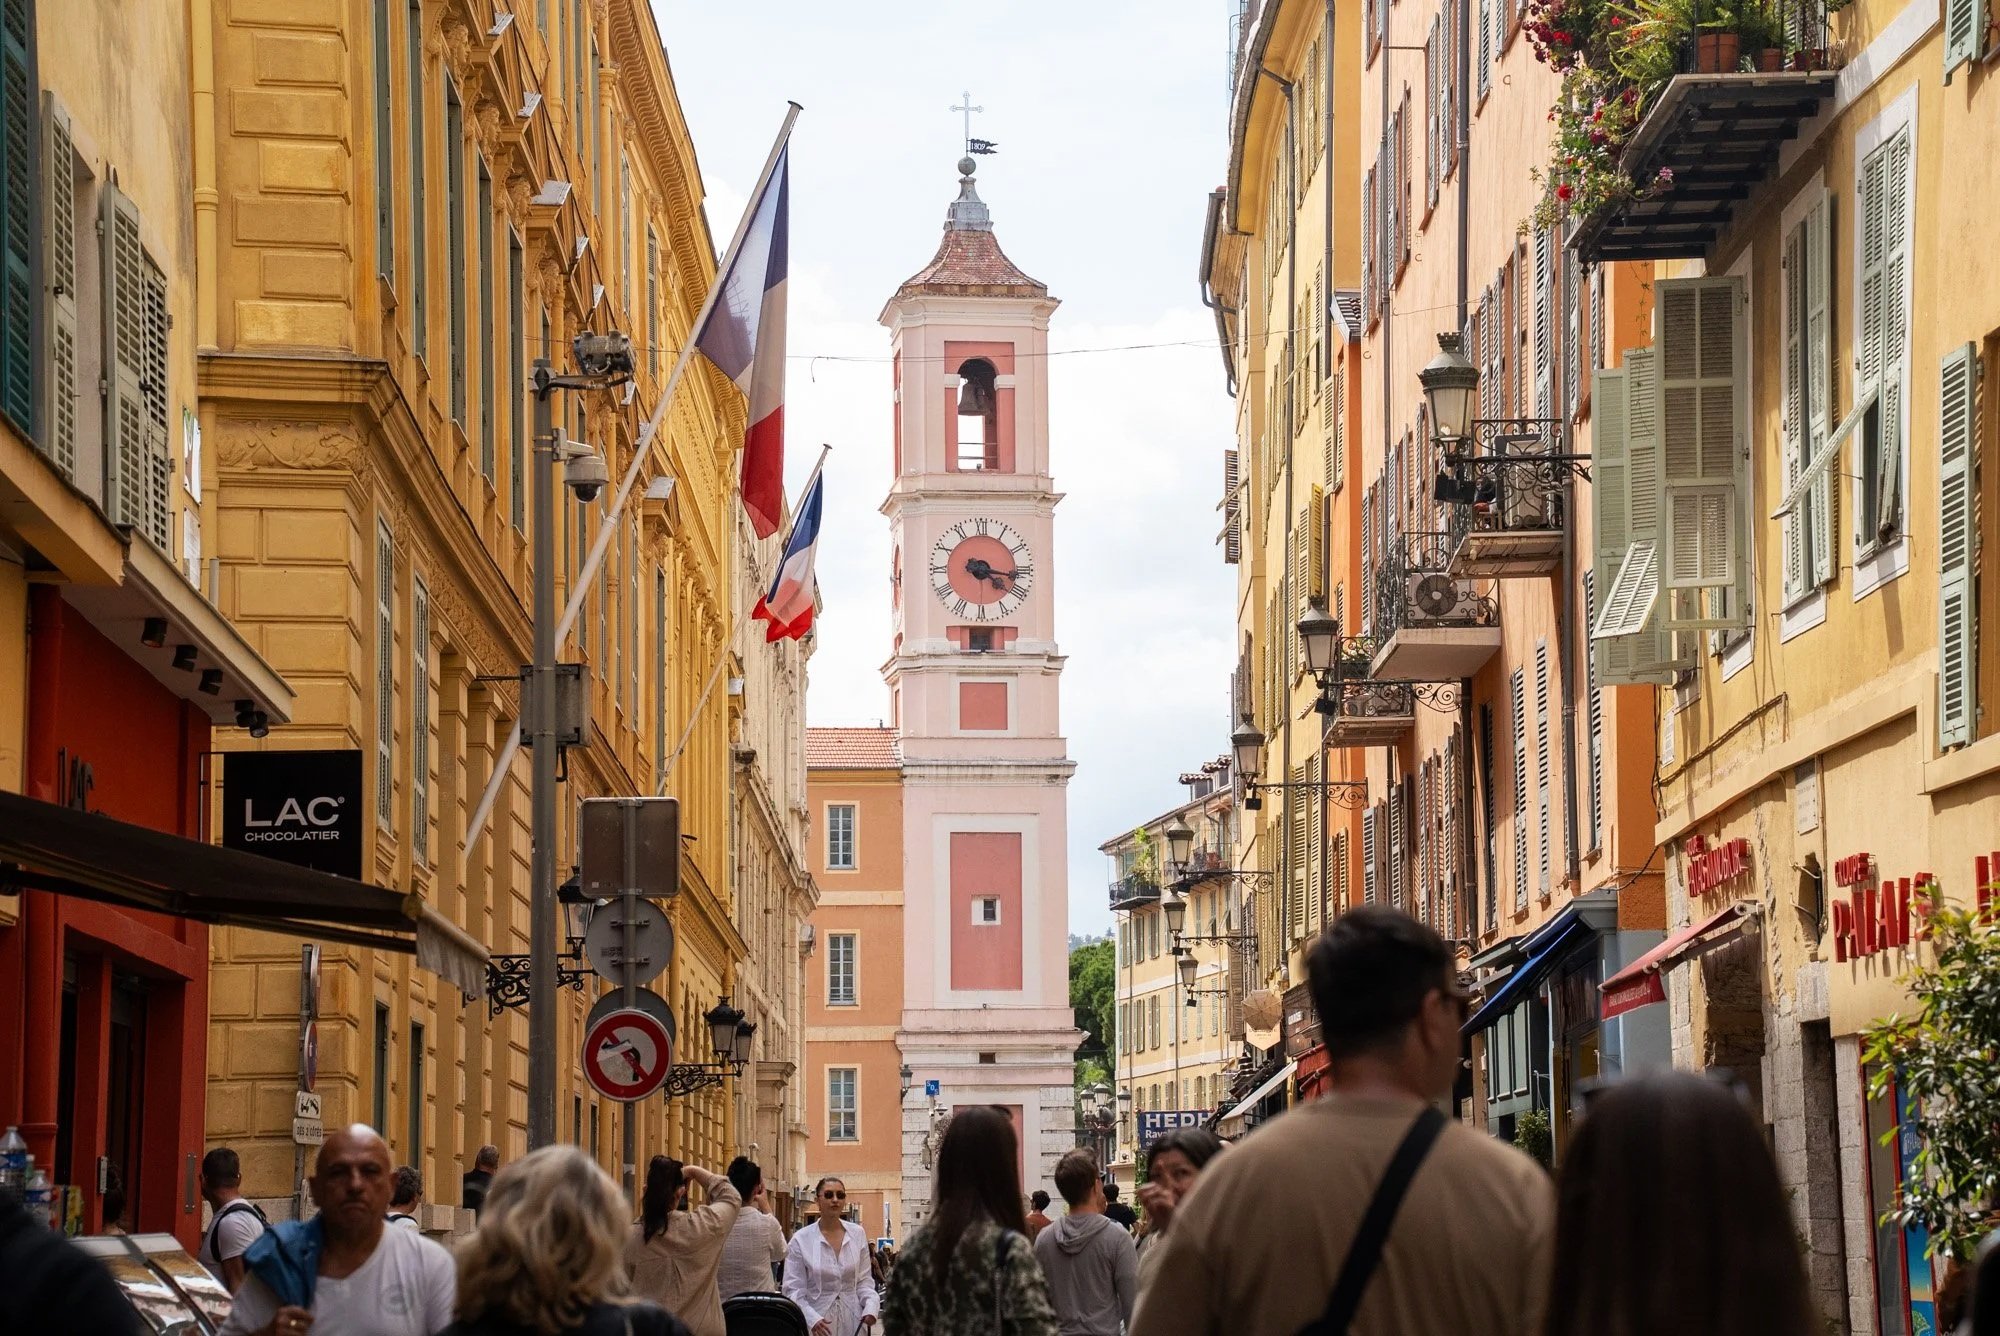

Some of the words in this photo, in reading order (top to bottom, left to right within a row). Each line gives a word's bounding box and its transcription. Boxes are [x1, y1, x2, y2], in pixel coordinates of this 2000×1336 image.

[971, 142, 986, 150] 1809
[954, 526, 967, 540] XI
[976, 521, 987, 535] XII
[998, 527, 1007, 540] I
[938, 543, 952, 555] X
[1010, 543, 1024, 555] II
[933, 565, 947, 574] IX
[936, 582, 953, 600] VIII
[954, 598, 967, 615] VII
[978, 604, 986, 620] VI
[999, 600, 1009, 614] V
[245, 831, 340, 842] CHOCOLATIER
[1832, 872, 1933, 963] PALAIS
